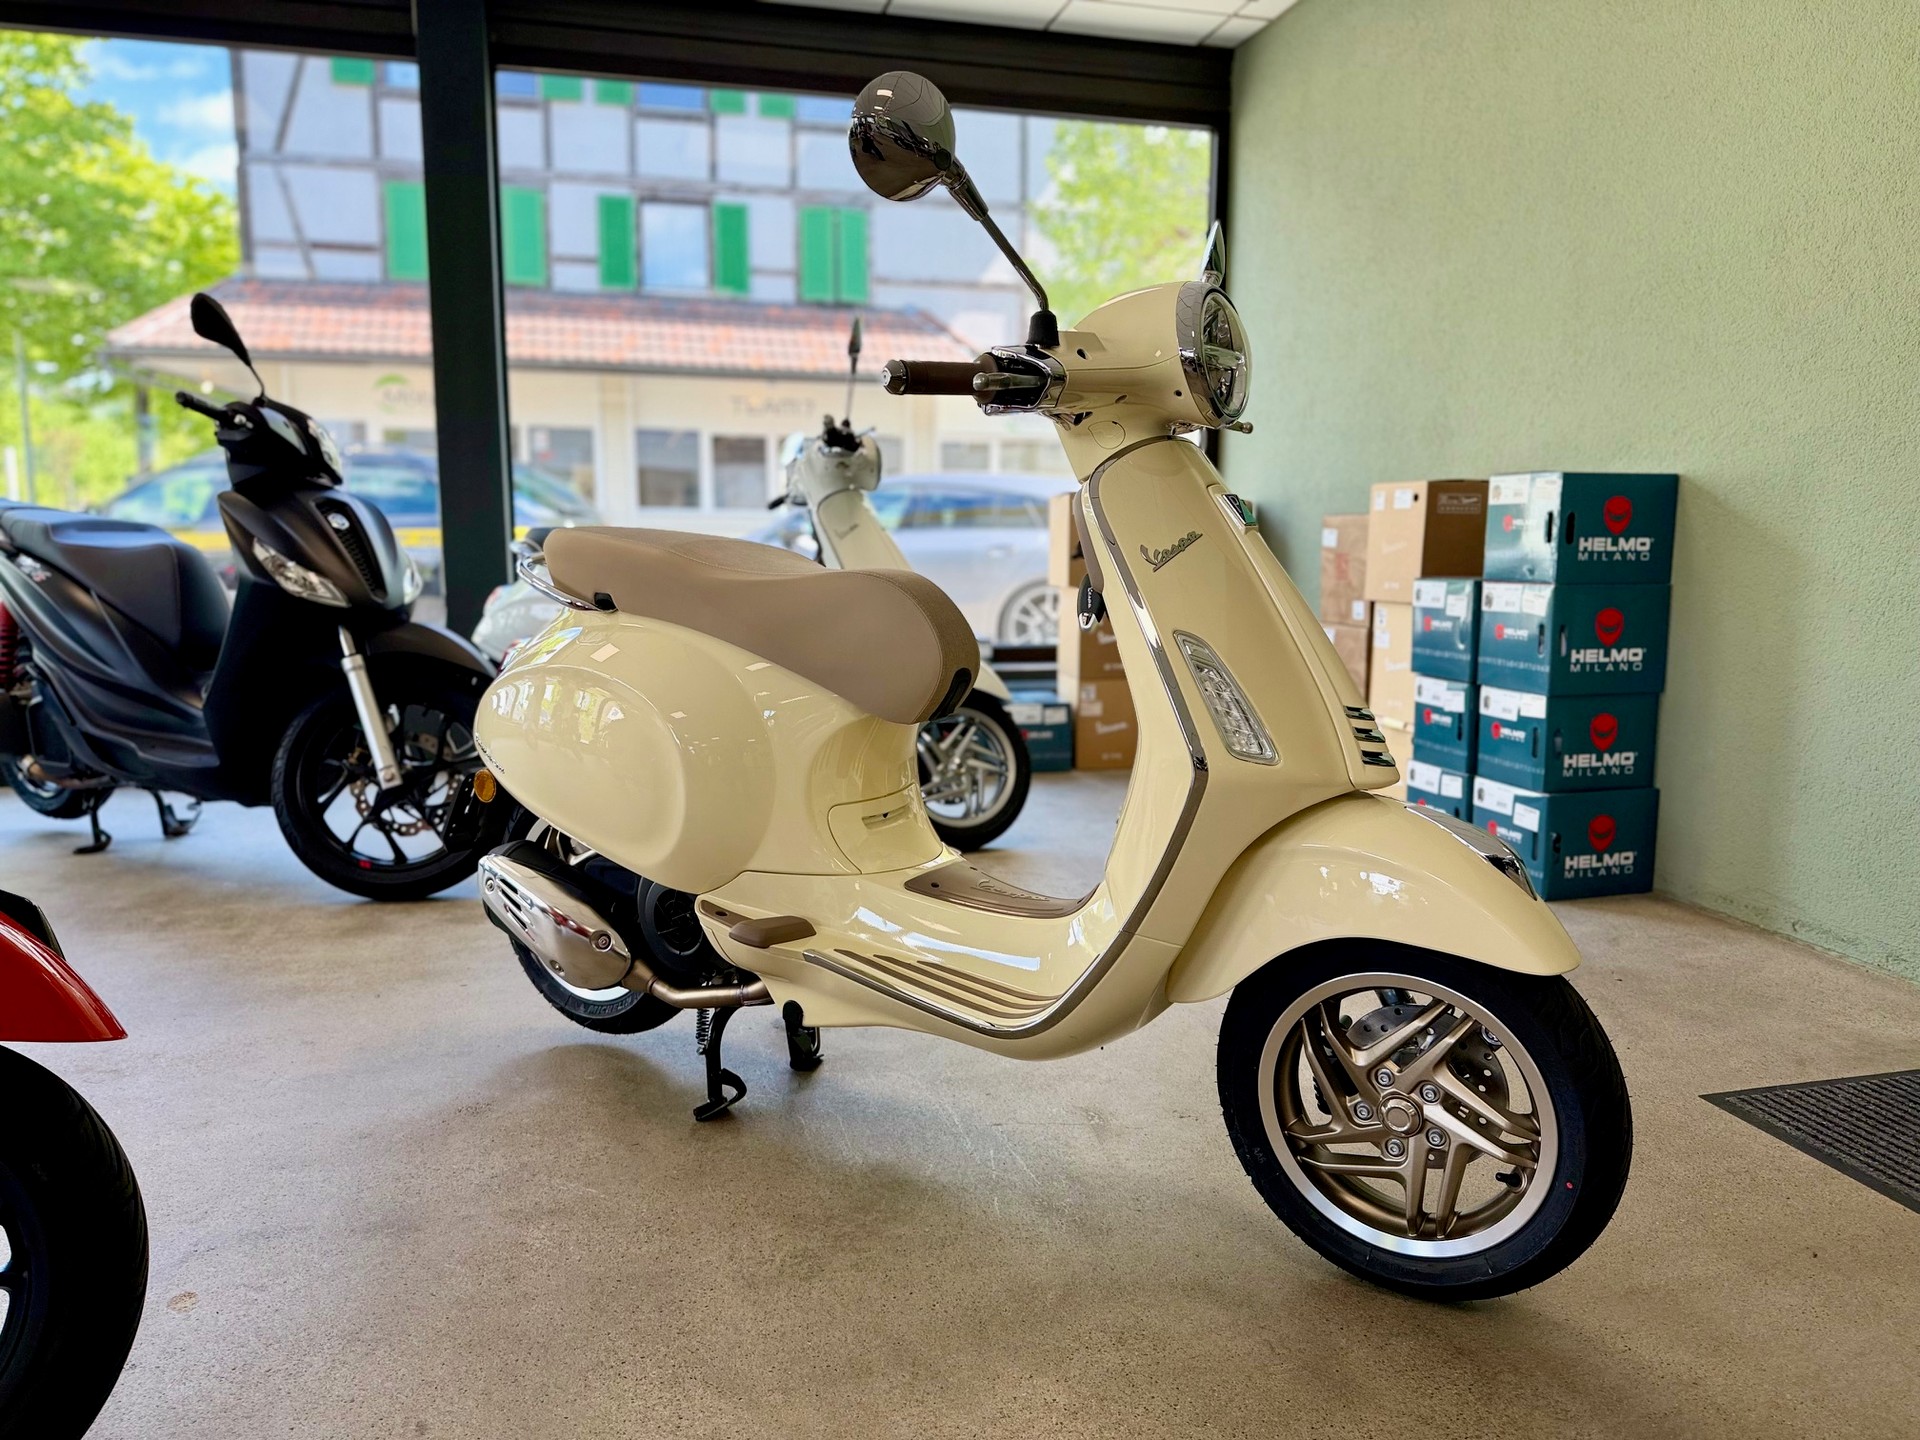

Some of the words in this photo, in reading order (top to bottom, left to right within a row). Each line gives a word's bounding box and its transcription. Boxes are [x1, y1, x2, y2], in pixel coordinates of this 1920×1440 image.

[1140, 531, 1203, 573] Vespa
[1578, 537, 1652, 552] HELMO
[1578, 551, 1651, 561] MILANO
[1571, 647, 1644, 664] HELMO
[1570, 661, 1643, 673] MILANO
[1563, 751, 1635, 769] HELMO
[1563, 765, 1634, 777] MILANO
[1564, 851, 1635, 870] HELMO
[1564, 864, 1634, 879] MILANO
[971, 879, 1050, 902] Vespa
